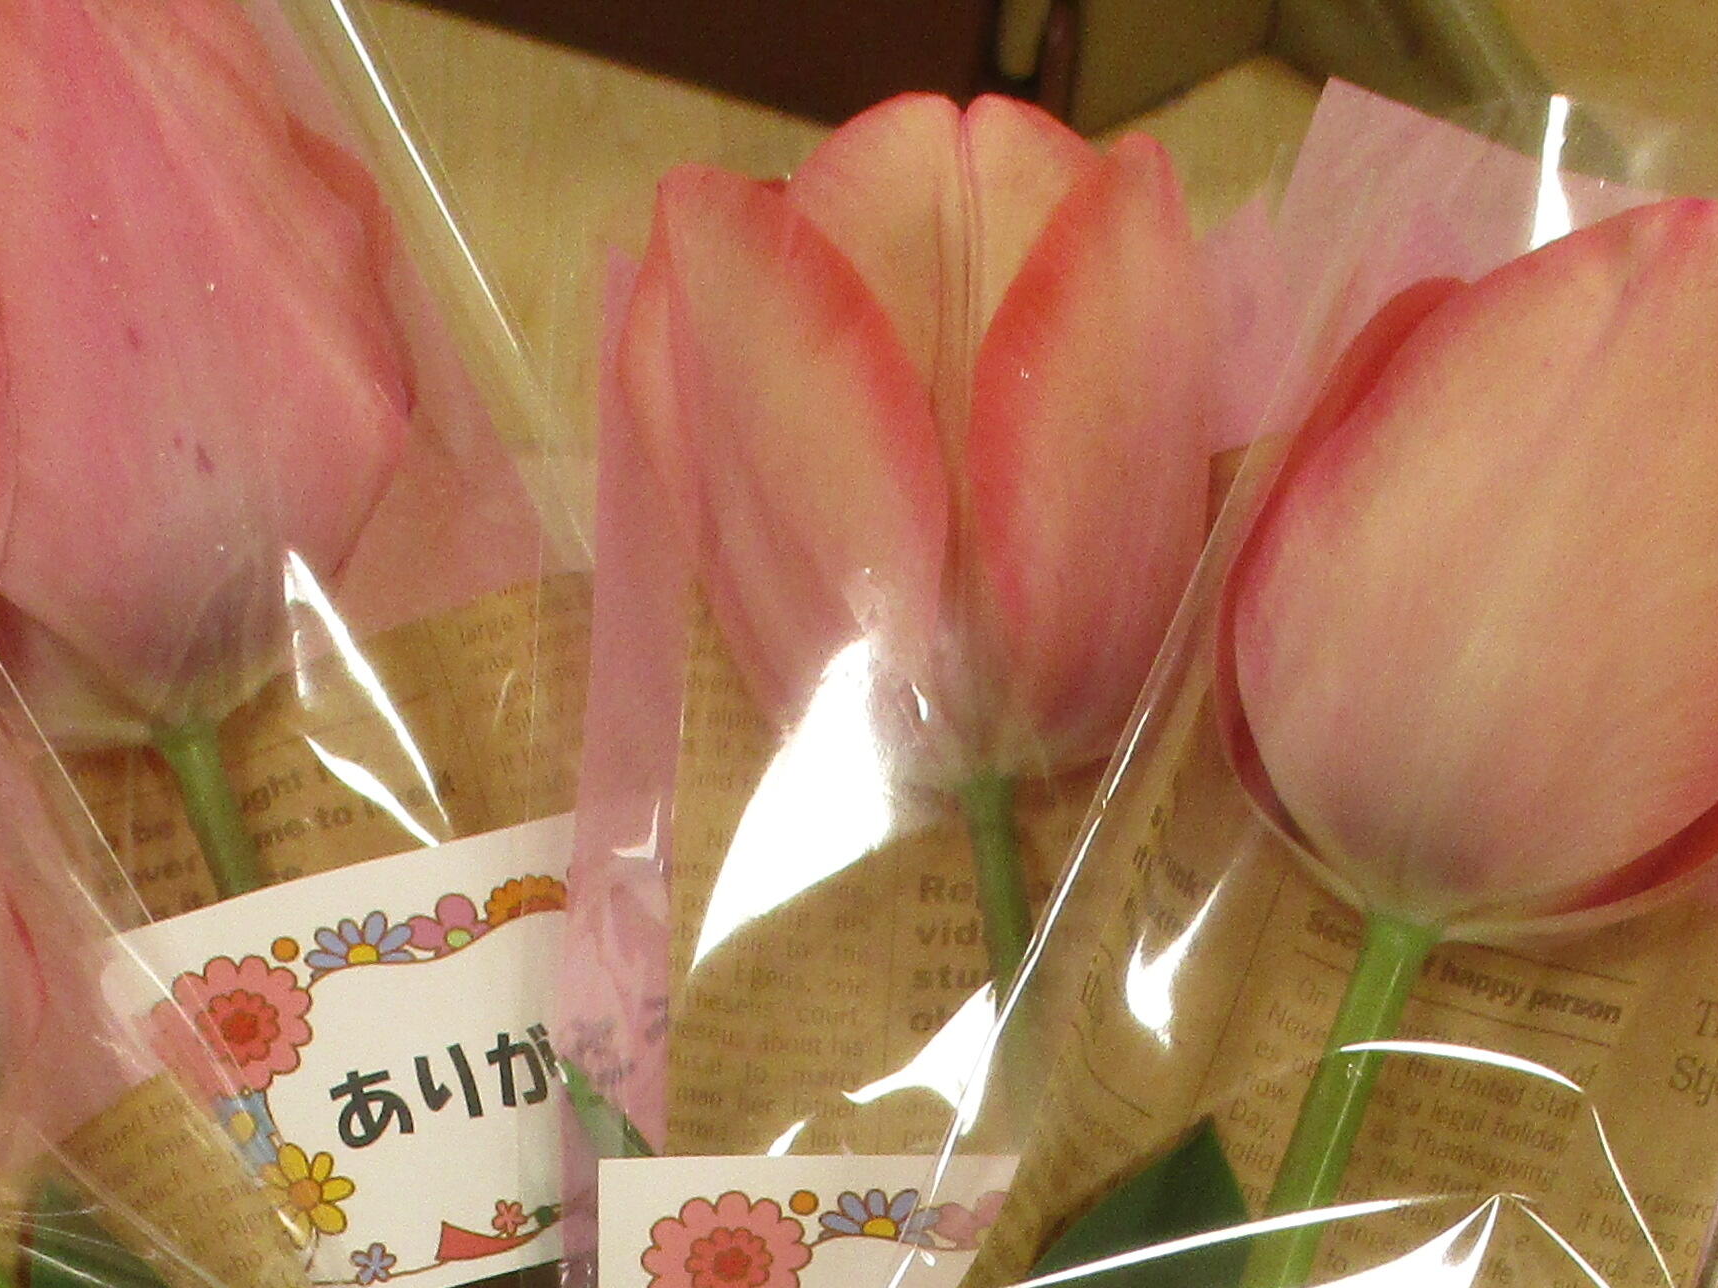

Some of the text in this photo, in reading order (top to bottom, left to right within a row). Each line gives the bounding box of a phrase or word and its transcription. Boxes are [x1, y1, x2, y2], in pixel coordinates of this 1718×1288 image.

[1439, 961, 1526, 1007] happy
[1528, 986, 1624, 1029] person
[1449, 1069, 1526, 1108] United
[1429, 1099, 1487, 1136] legal
[1409, 1128, 1561, 1193] Thanksgiving
